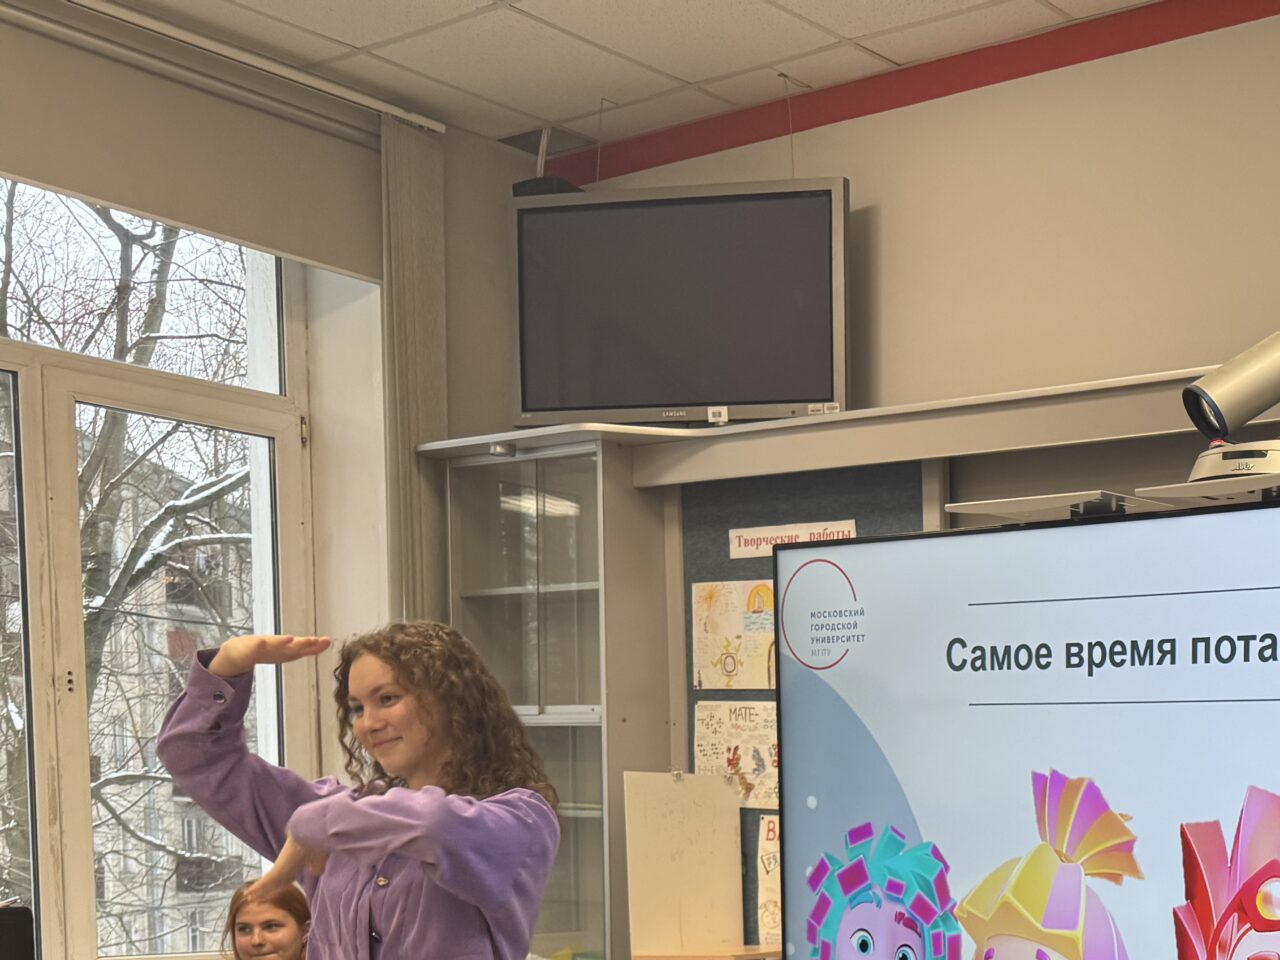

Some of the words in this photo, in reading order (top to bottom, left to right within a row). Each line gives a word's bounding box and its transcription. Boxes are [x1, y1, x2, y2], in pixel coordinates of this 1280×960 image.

[735, 533, 800, 550] Творческие
[809, 527, 851, 542] работы
[810, 607, 865, 619] МОСКОВСКИЙ
[810, 620, 858, 631] ГОРОДСКОЙ
[810, 634, 866, 644] УНИВЕРСИТЕТ
[946, 637, 1053, 672] Самое
[1065, 637, 1177, 677] время
